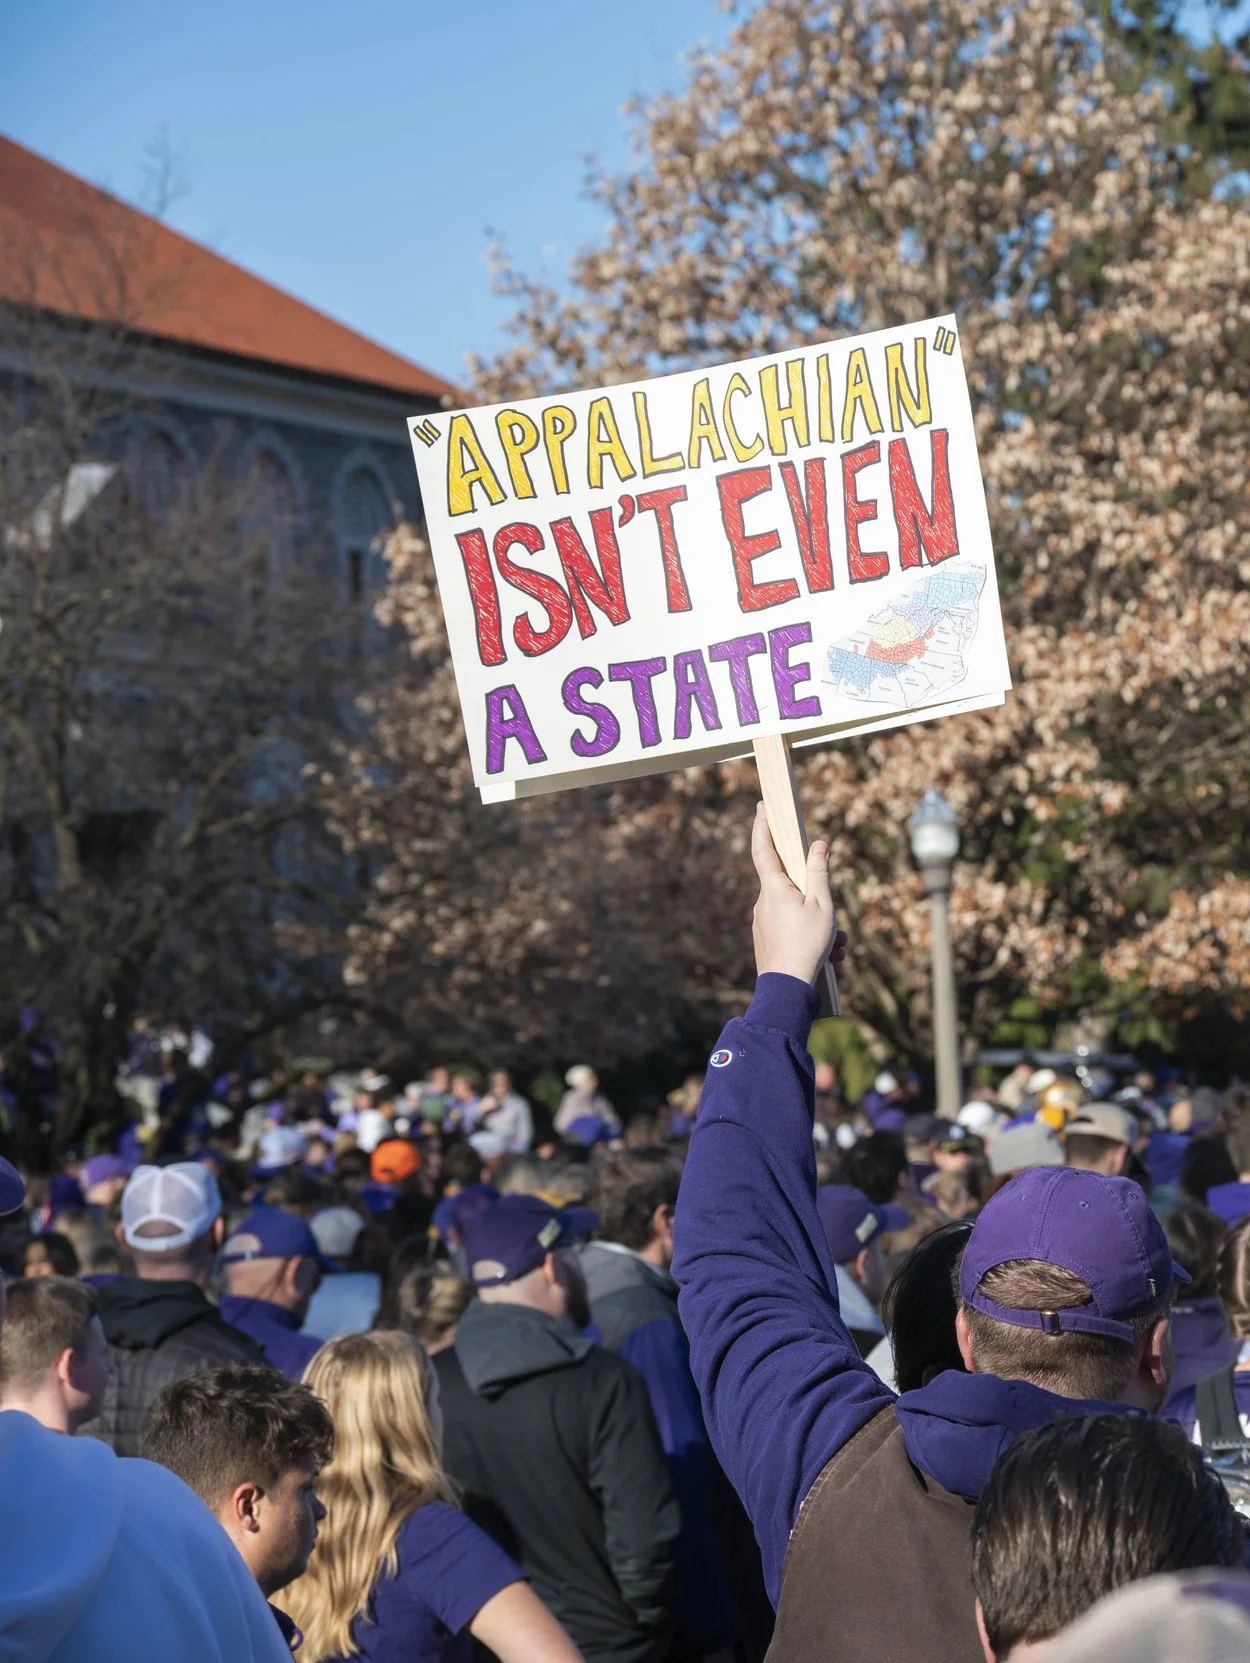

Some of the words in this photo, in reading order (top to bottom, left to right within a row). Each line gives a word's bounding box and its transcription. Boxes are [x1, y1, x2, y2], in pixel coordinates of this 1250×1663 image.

[413, 327, 956, 516] "APPALACHIAN"
[455, 485, 693, 666] ISN'T
[716, 428, 960, 614] EVEN
[485, 684, 547, 774] A
[562, 621, 822, 758] STATE
